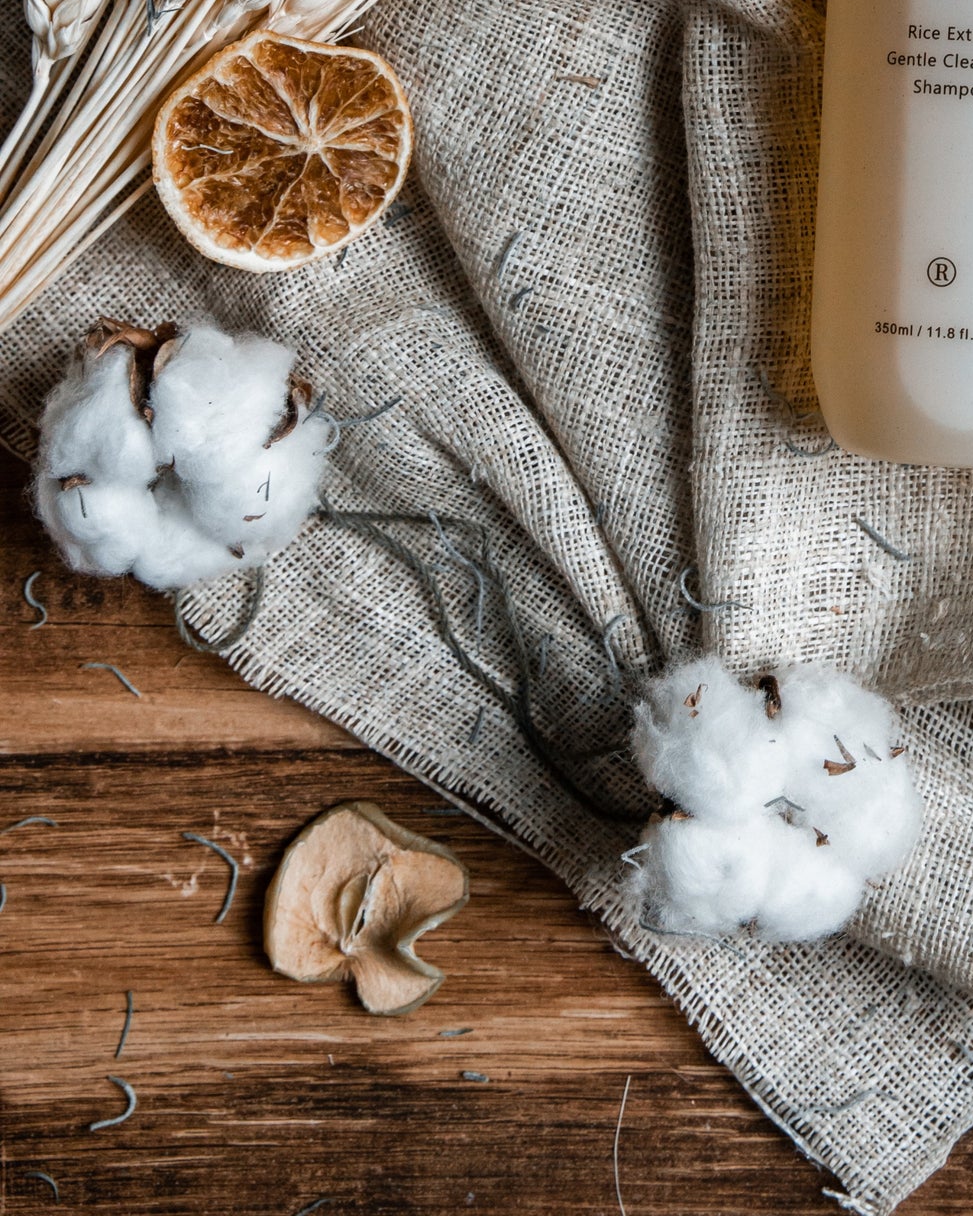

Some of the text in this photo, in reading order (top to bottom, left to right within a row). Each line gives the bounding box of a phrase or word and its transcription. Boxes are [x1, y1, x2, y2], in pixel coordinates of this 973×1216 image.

[908, 25, 941, 40] Rice
[887, 51, 937, 67] Gentle
[875, 321, 913, 337] 350ml
[927, 326, 956, 340] 11.8
